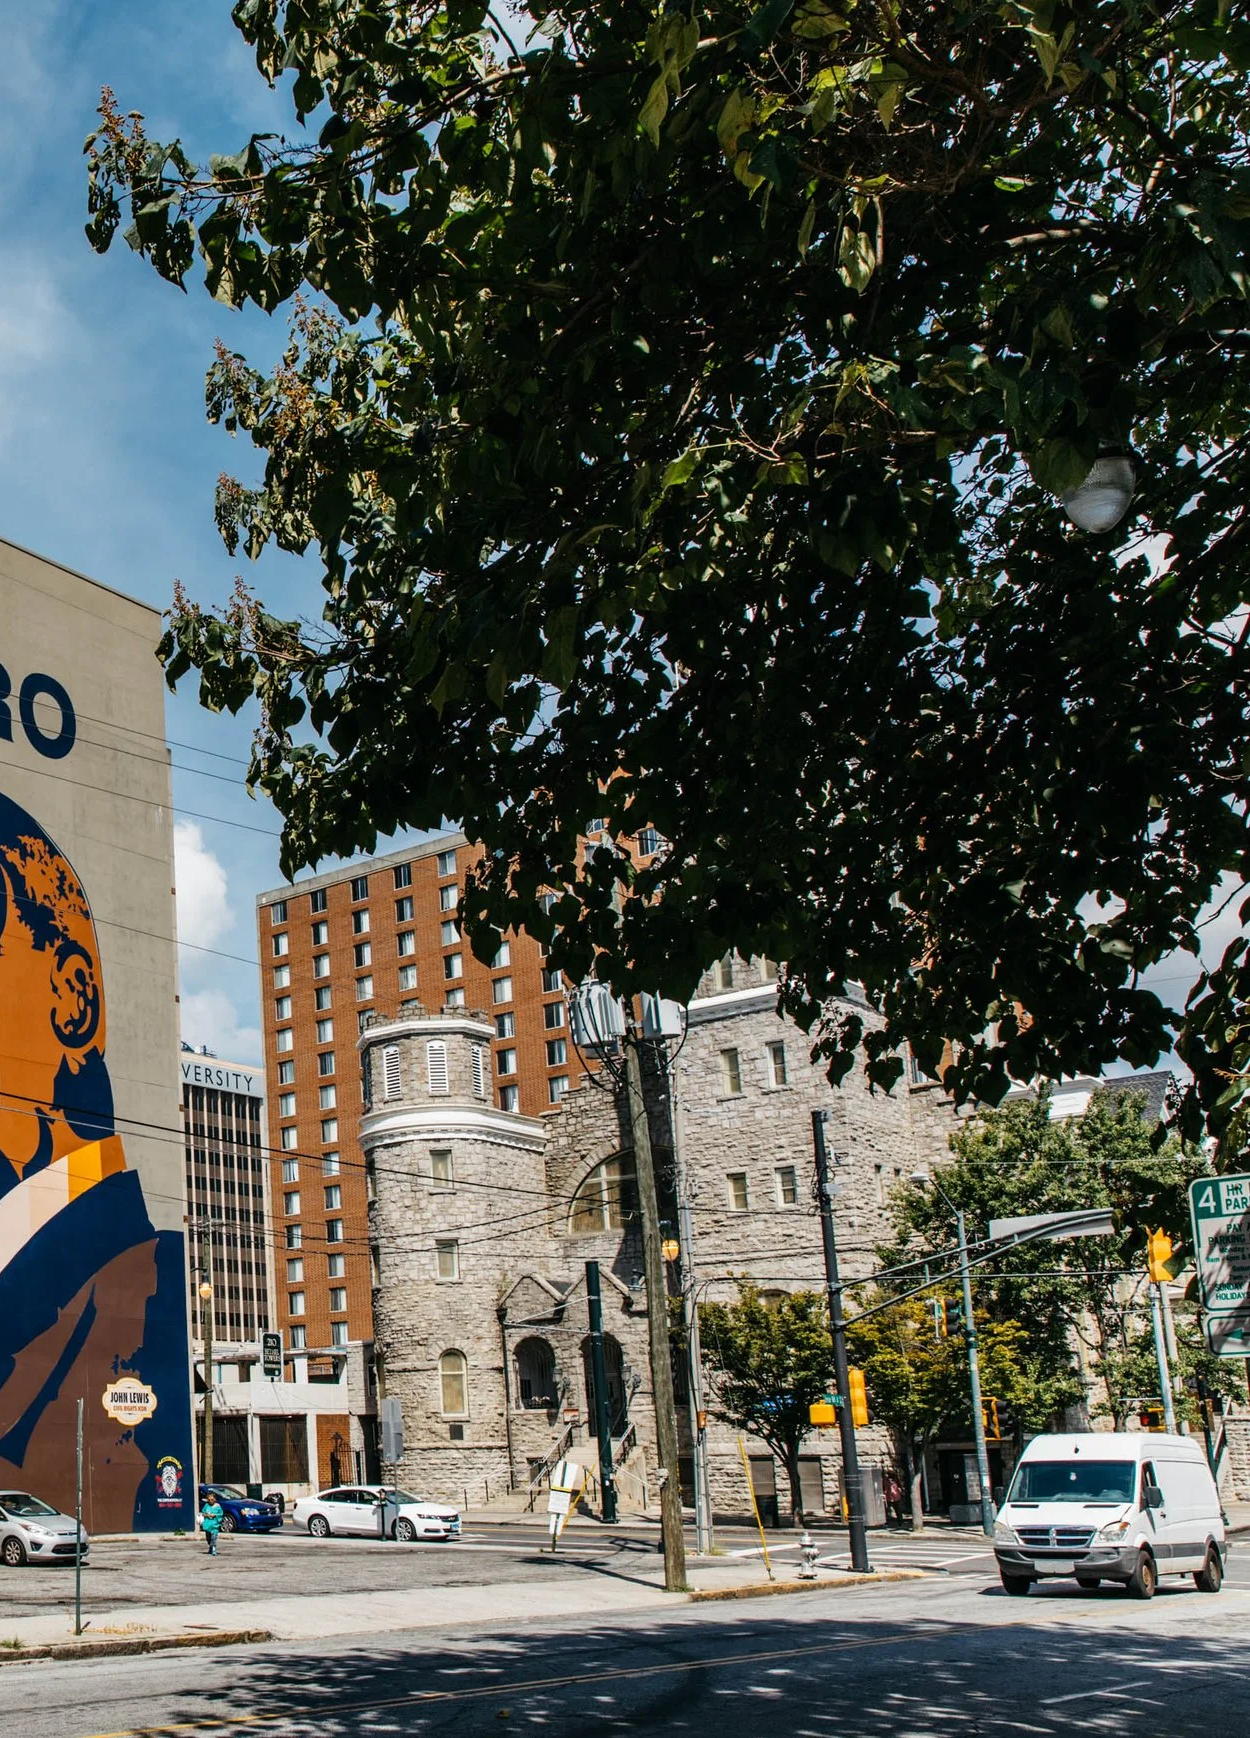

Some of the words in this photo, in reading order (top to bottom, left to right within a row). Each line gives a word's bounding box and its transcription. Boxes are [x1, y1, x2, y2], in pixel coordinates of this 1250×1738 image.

[182, 1063, 253, 1092] VERSITY
[1226, 1183, 1244, 1197] HR
[1198, 1185, 1217, 1214] 4
[1225, 1197, 1250, 1212] PAR
[1208, 1234, 1246, 1246] PARKING
[110, 1391, 129, 1404] JOHN
[129, 1392, 150, 1404] LEWIS
